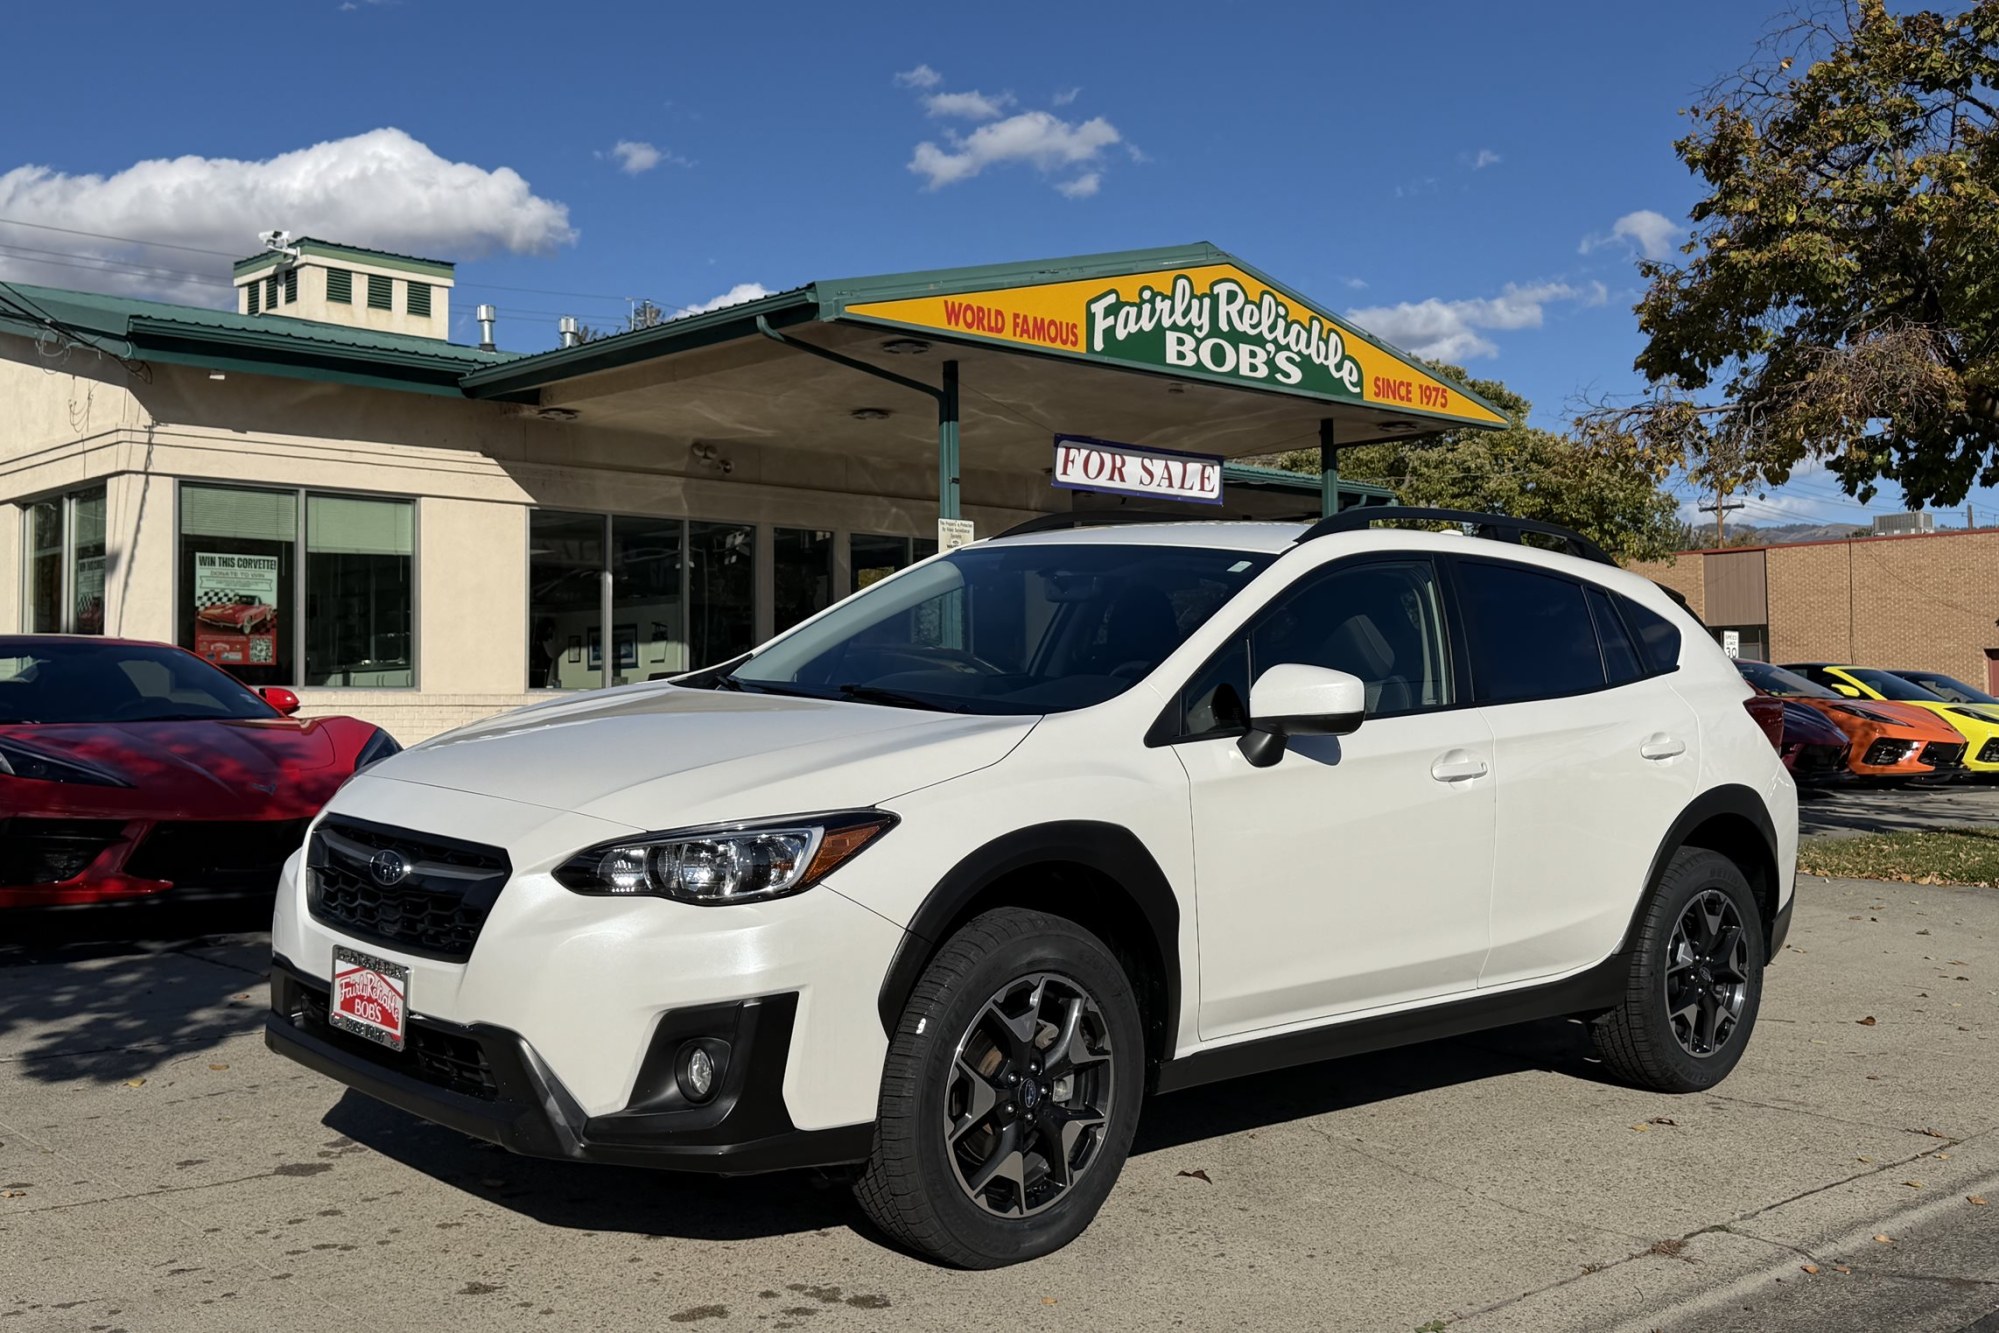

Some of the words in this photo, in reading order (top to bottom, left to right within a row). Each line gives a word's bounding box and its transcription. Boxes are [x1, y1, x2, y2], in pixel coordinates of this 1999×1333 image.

[944, 299, 1005, 334] WORLD
[1012, 312, 1079, 347] FAMOUS
[1090, 278, 1210, 352] Fairly
[1213, 281, 1361, 393] Reliable
[1165, 330, 1303, 385] BOB'S
[1373, 376, 1412, 403] SINCE
[1418, 383, 1448, 408] 1975
[1060, 446, 1127, 483] FOR
[1139, 456, 1215, 493] SALE
[198, 555, 216, 567] WIN
[218, 556, 235, 568] THIS
[237, 557, 277, 570] CORVETTE!
[1726, 647, 1737, 658] 30
[340, 974, 367, 1001] Fairly
[366, 972, 400, 1022] Reliable
[354, 998, 382, 1023] BOB'S
